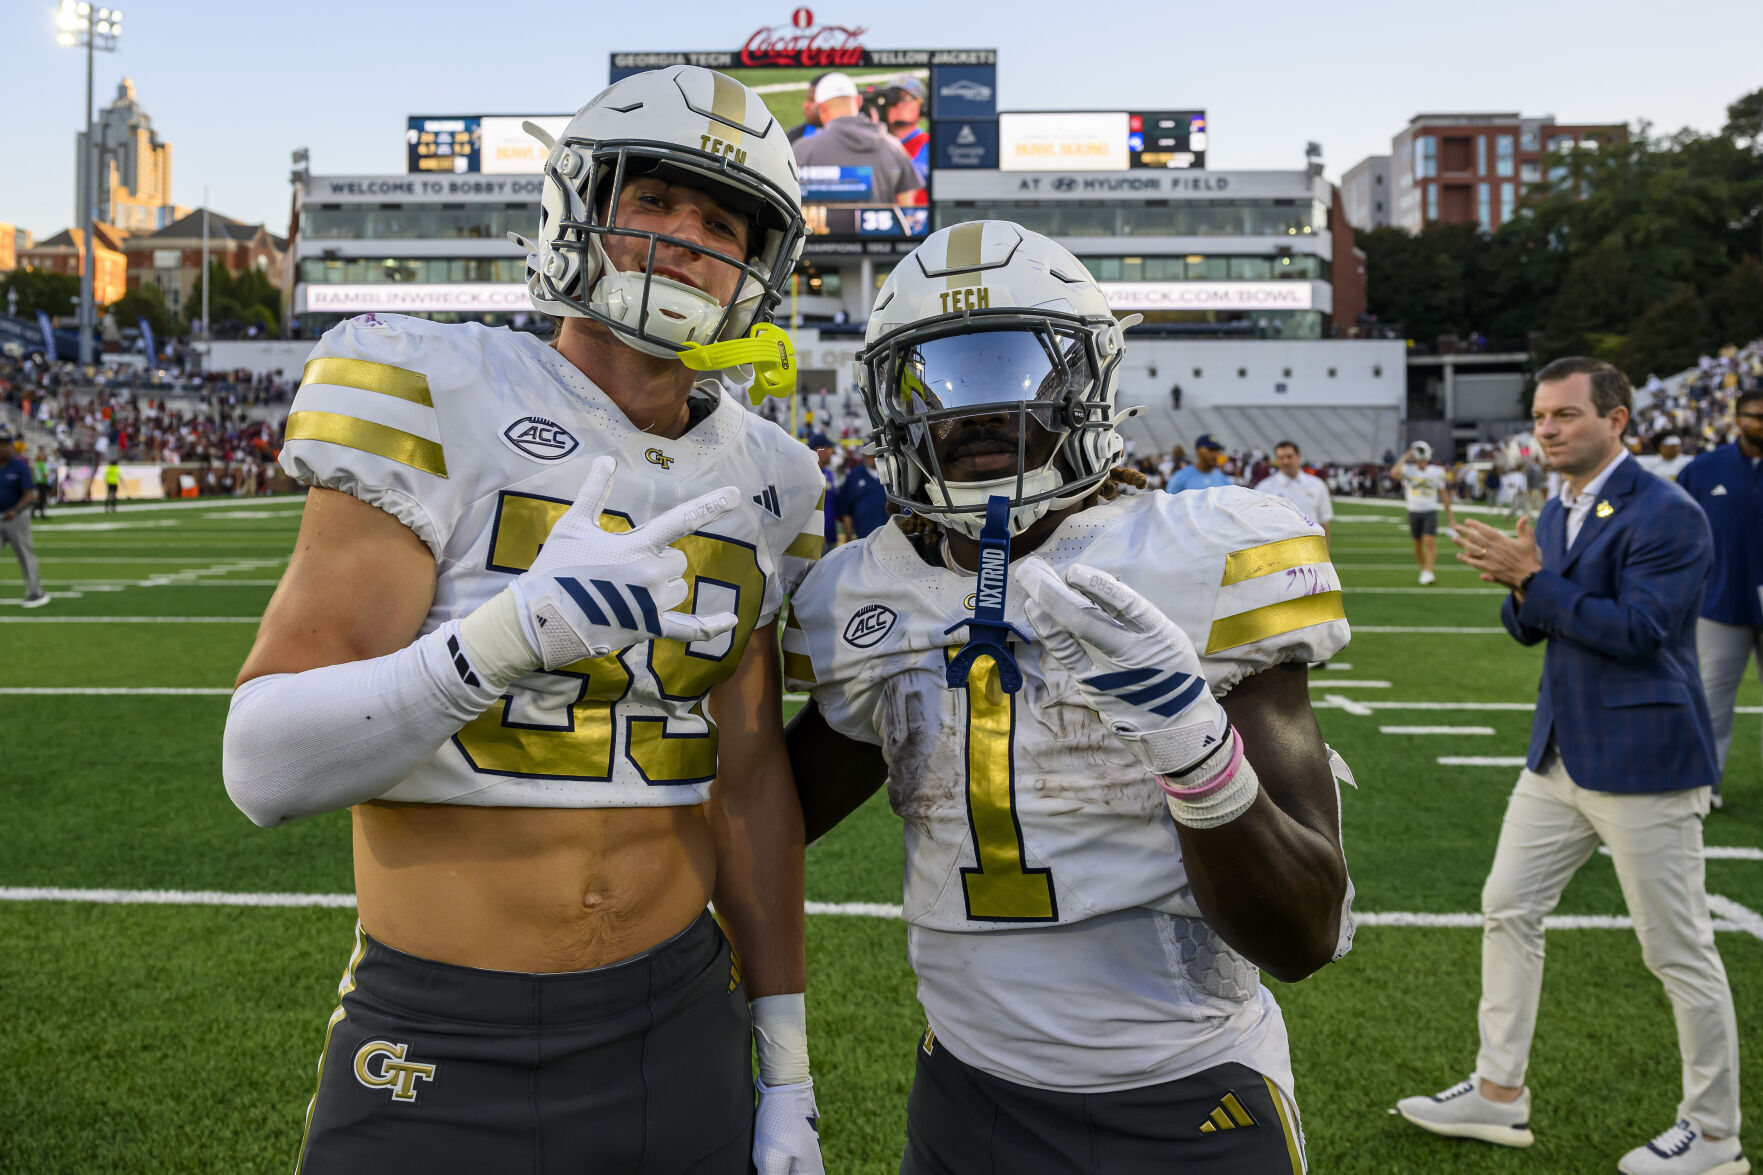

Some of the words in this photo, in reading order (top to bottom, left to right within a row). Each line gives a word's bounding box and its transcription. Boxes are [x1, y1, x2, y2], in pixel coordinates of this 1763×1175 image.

[740, 26, 869, 66] Coca-Cola
[871, 51, 929, 65] YELLOW
[932, 51, 994, 64] JACKETS
[615, 54, 684, 67] GEORGIA
[690, 53, 731, 66] TECH
[701, 134, 747, 165] TECH
[330, 181, 414, 195] WELCOME
[422, 181, 443, 194] TO
[449, 181, 506, 194] BOBBY
[511, 181, 544, 194] DOD
[1018, 178, 1041, 191] AT
[1083, 178, 1160, 191] HYUNDAI
[1171, 178, 1229, 191] FIELD
[940, 287, 989, 315] TECH
[517, 425, 567, 446] ACC
[644, 447, 674, 470] GT
[683, 496, 728, 522] ADIZERO
[978, 548, 1006, 609] NXTRND
[851, 610, 888, 638] ACC
[942, 641, 1060, 922] 1
[353, 1040, 437, 1102] GT
